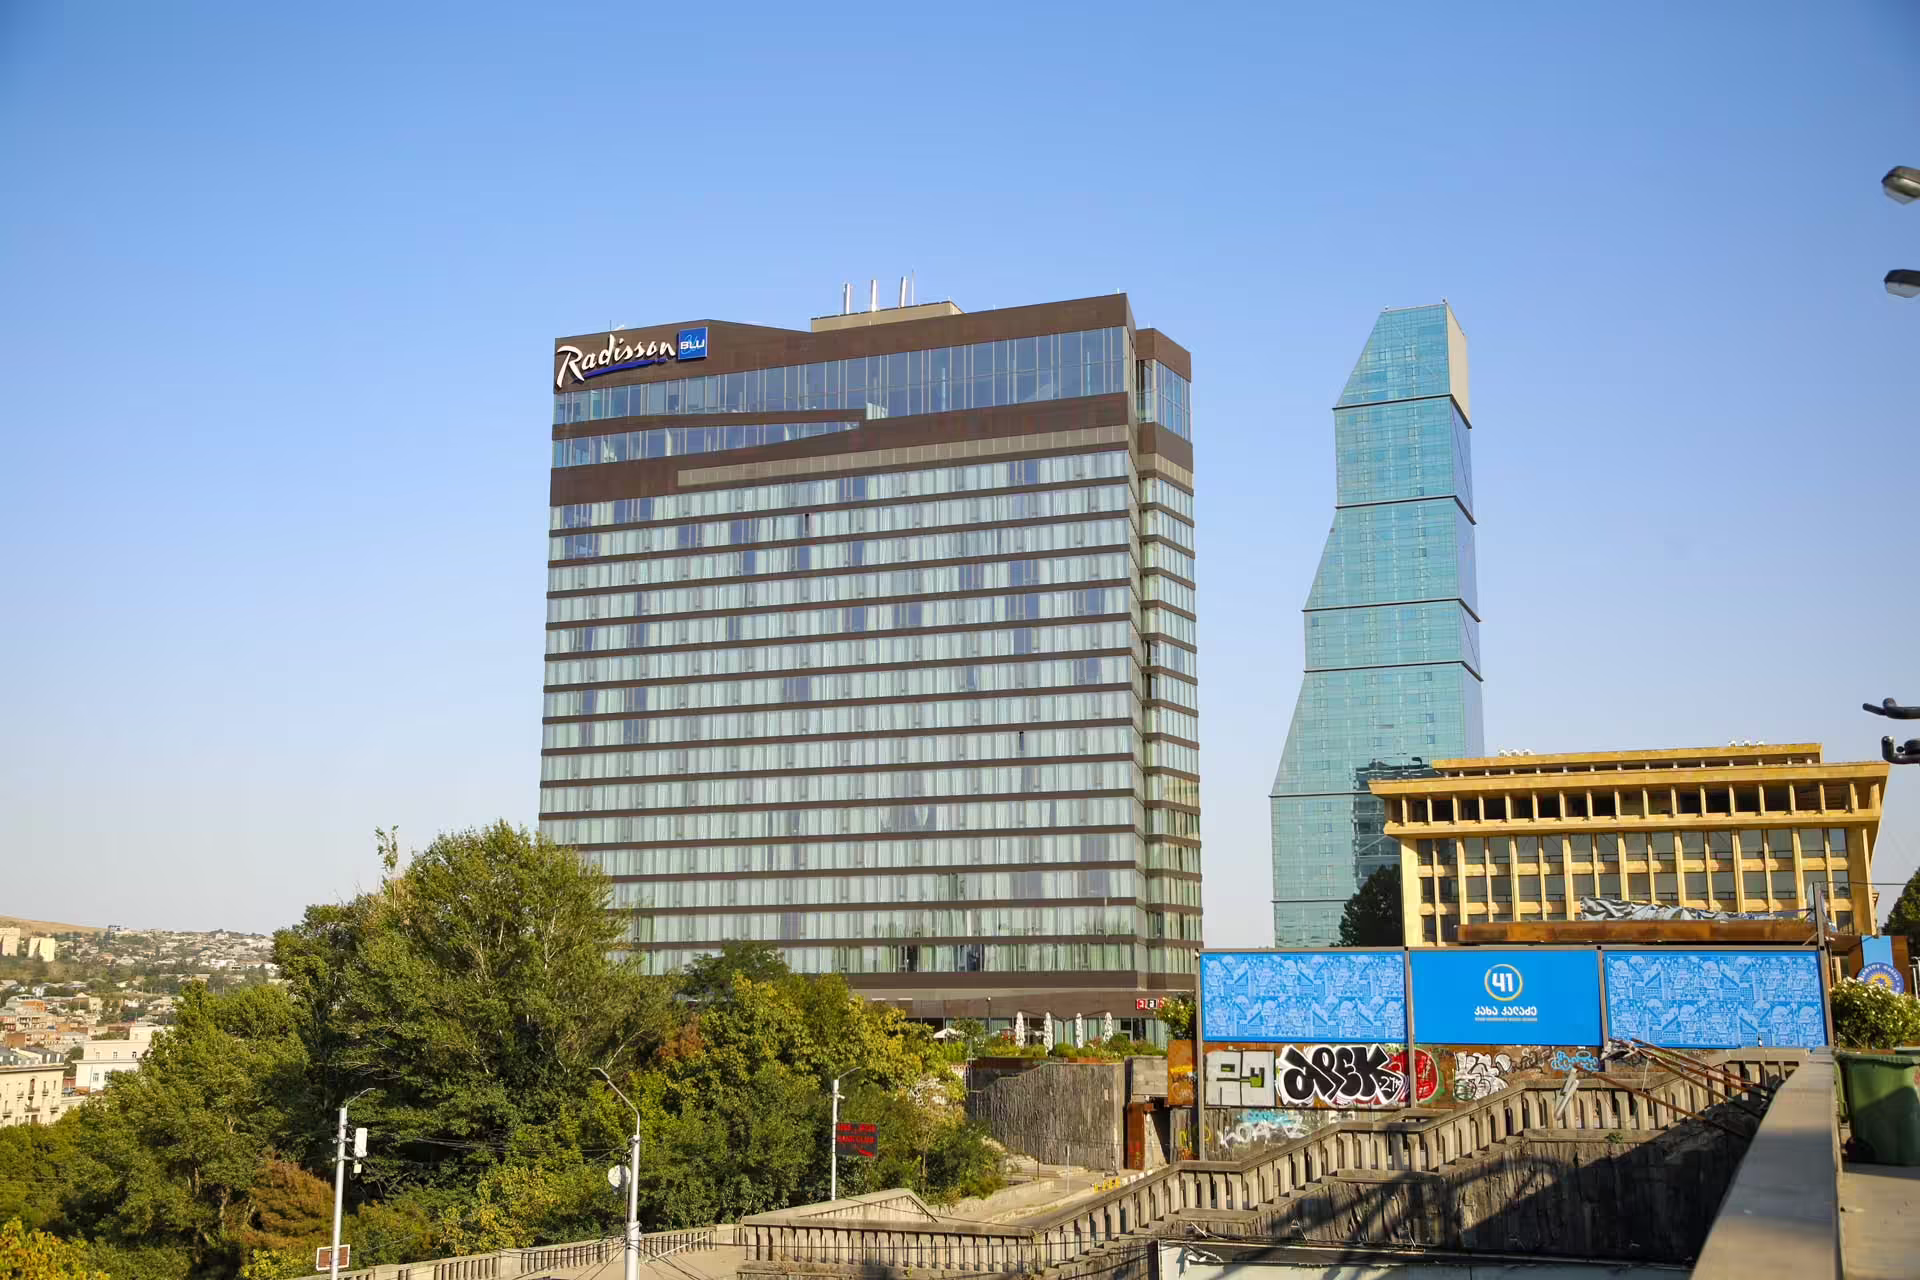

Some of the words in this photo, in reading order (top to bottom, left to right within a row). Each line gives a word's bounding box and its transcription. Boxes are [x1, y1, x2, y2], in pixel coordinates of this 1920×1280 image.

[556, 333, 677, 389] Radisson
[680, 339, 705, 350] BLU
[1491, 972, 1514, 993] 41
